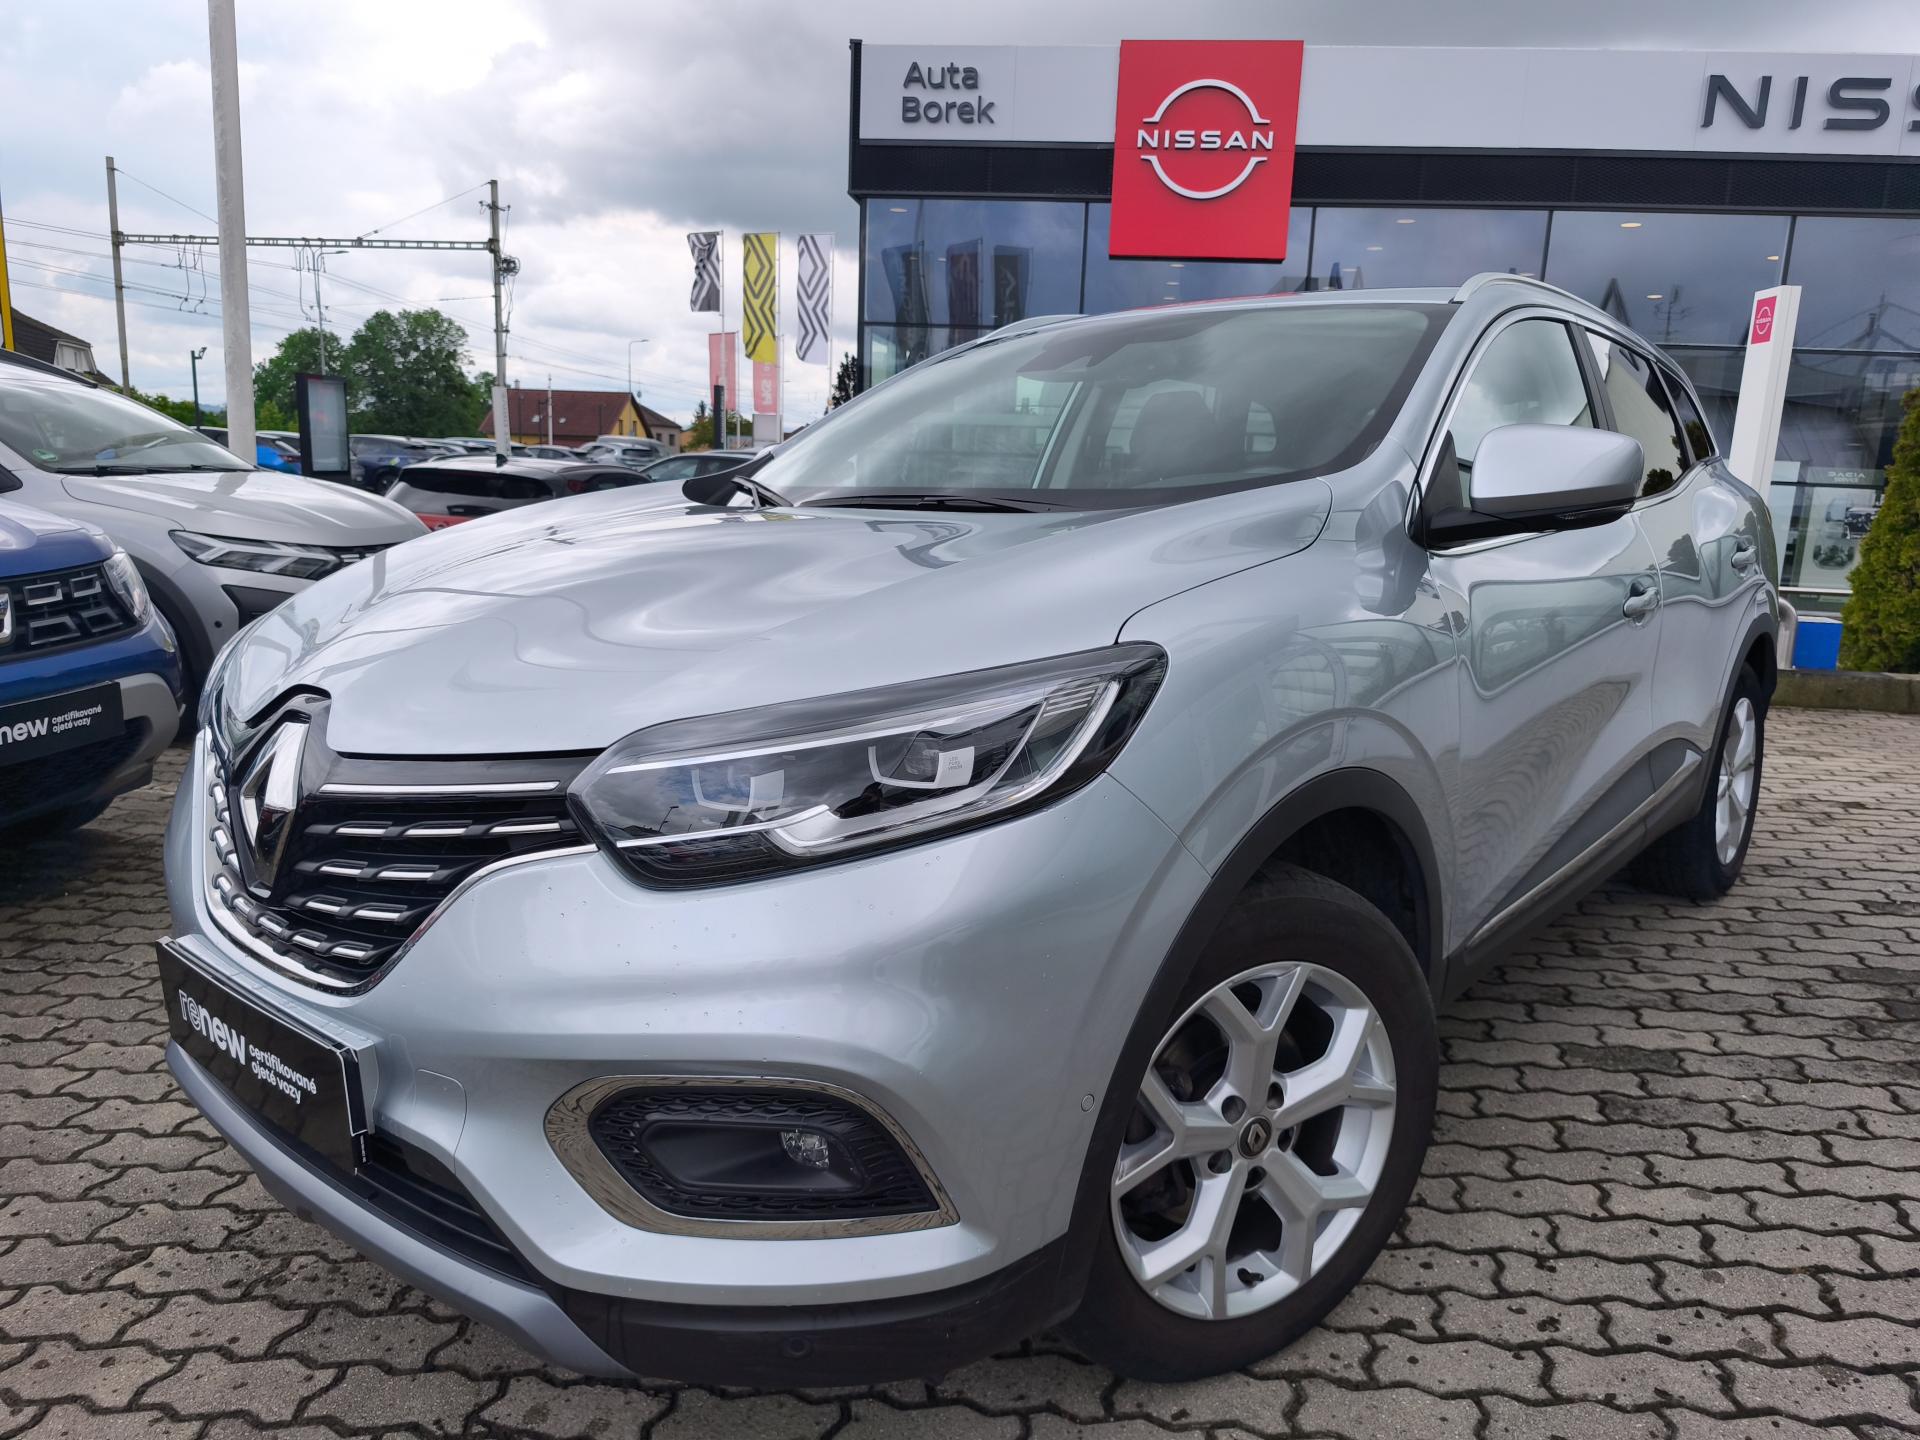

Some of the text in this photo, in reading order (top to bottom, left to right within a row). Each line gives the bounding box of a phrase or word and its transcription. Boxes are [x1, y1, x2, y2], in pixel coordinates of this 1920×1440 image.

[903, 61, 979, 89] Auta
[902, 95, 995, 124] Borek
[1701, 74, 1920, 132] NIS
[1137, 129, 1274, 150] NISSAN
[52, 704, 102, 724] certifikované
[52, 717, 91, 733] ojeté vozy
[179, 989, 246, 1066] renew
[249, 1044, 317, 1094] certifikované
[251, 1061, 301, 1104] ojeté vozy
